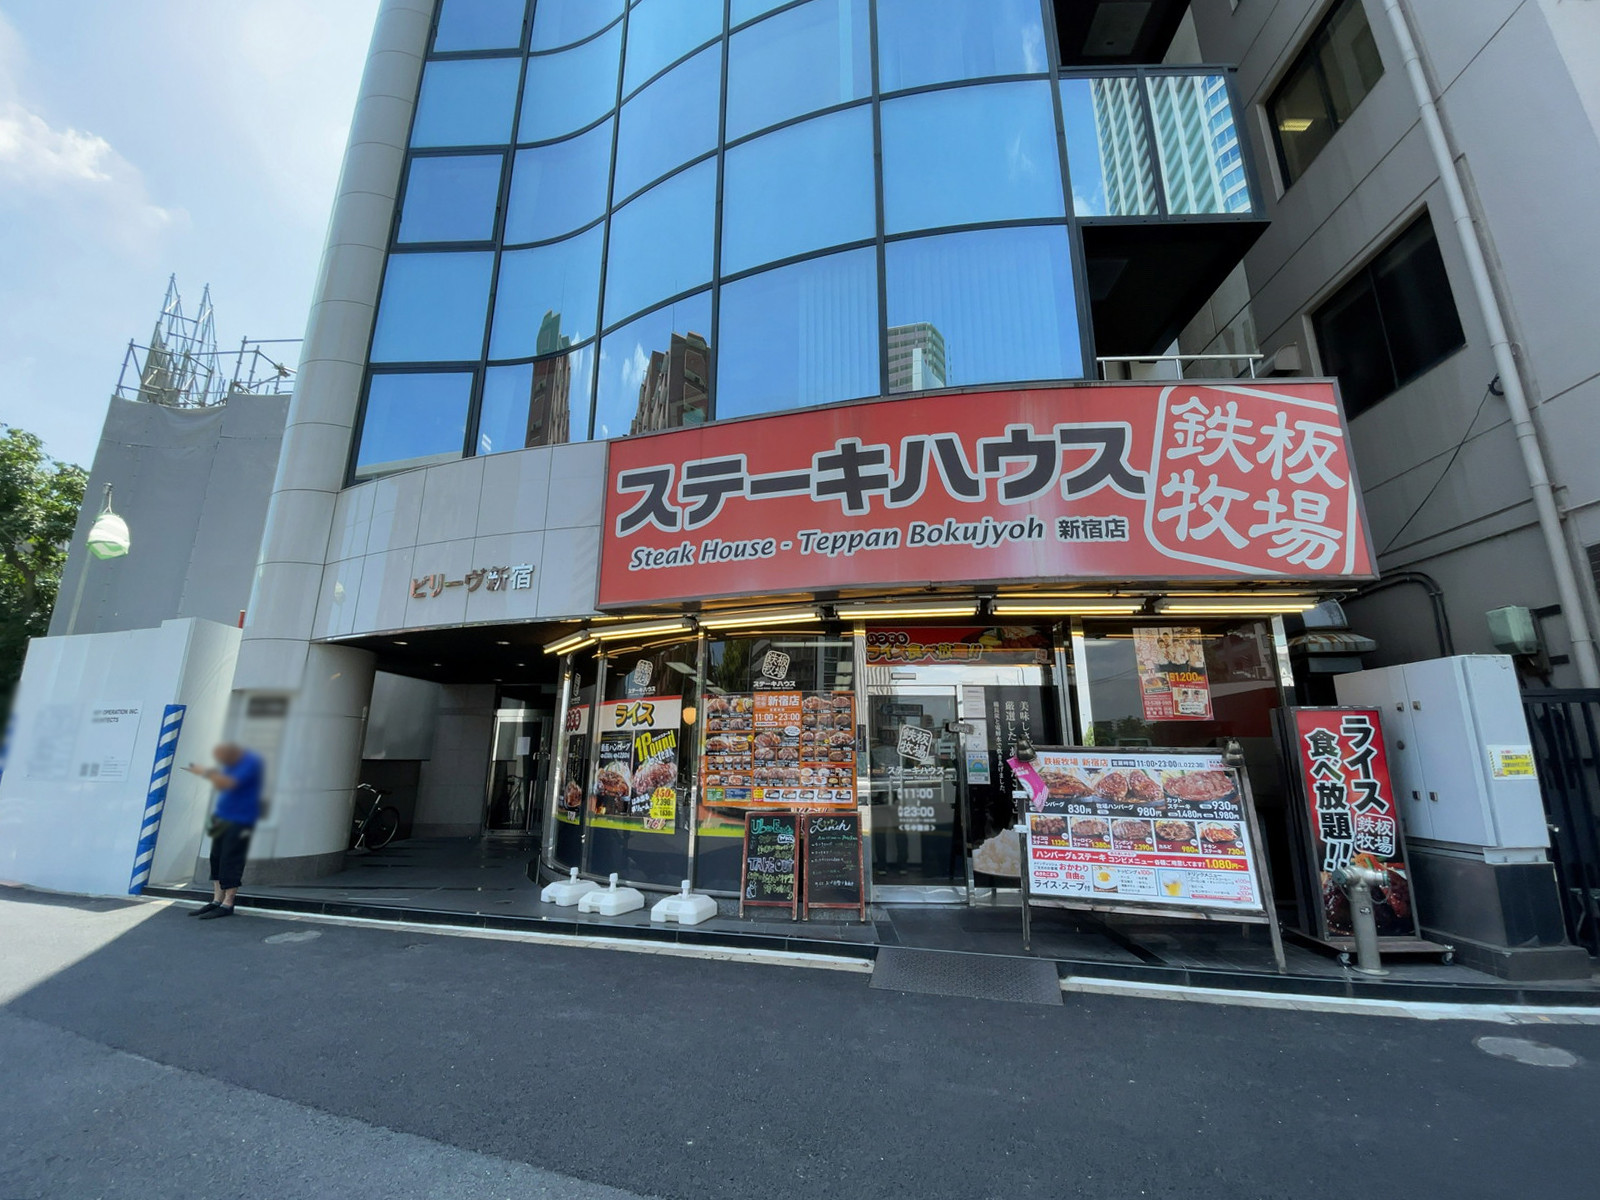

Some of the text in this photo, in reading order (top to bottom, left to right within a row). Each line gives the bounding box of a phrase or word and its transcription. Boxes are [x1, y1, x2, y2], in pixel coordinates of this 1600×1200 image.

[1166, 396, 1346, 490] 鉄板
[618, 424, 1147, 534] ステーキハウス
[1058, 517, 1127, 540] 新宿店
[1157, 468, 1343, 570] 牧場
[630, 543, 694, 568] Steak
[701, 539, 774, 563] House
[799, 530, 898, 556] Teppan
[909, 517, 1044, 547] Bokujyoh
[867, 632, 908, 643] いつでも
[616, 702, 654, 727] ライス
[1044, 757, 1108, 767] 鉄板牧場 新宿店
[1340, 716, 1389, 814] ライス
[1068, 804, 1092, 814] 830円
[1137, 806, 1162, 817] 980円
[1211, 801, 1238, 811] 930円
[1357, 816, 1393, 836] 鉄板
[1356, 833, 1393, 853] 牧場
[1060, 863, 1089, 872] おかわり
